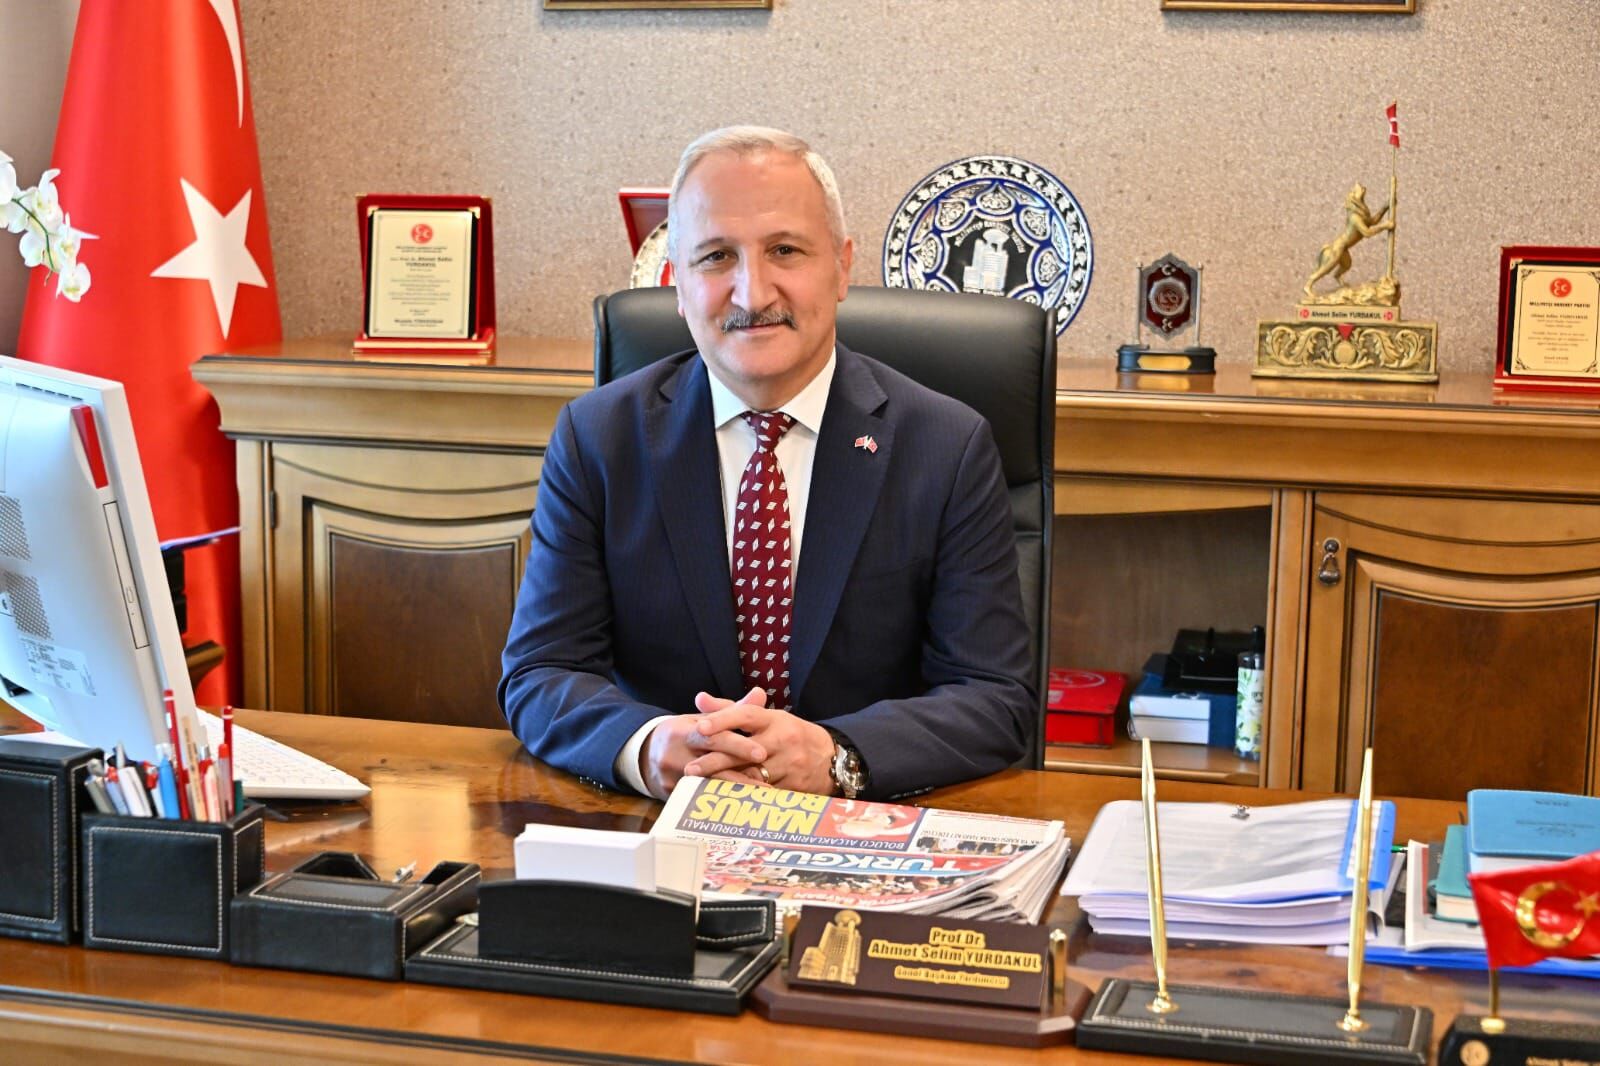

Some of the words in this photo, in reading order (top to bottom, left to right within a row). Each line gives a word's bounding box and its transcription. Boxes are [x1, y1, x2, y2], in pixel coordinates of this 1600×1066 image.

[689, 793, 820, 835] NAMUS
[682, 818, 745, 837] SORULMALI
[931, 930, 961, 944] Prof
[964, 933, 981, 945] Dr
[871, 941, 918, 958] Ahmet
[921, 945, 963, 961] Selim
[965, 950, 1039, 969] YURDAKUL
